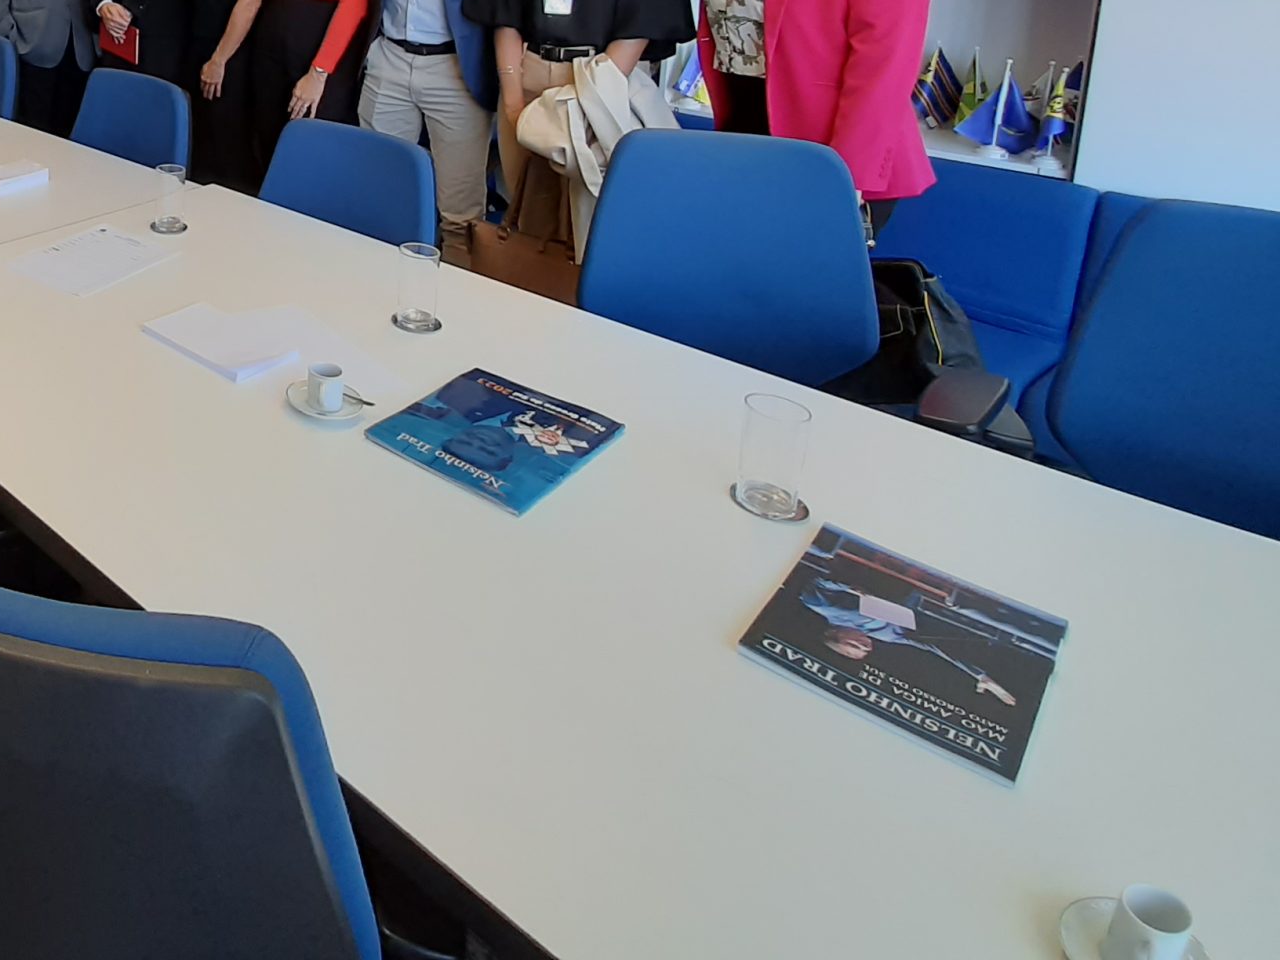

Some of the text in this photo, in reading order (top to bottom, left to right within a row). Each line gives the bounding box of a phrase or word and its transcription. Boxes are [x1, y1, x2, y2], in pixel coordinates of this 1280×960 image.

[396, 432, 506, 489] Nelsinho Trad
[762, 638, 1001, 761] NELSINHO TRAD
[858, 669, 882, 687] DE
[863, 664, 1008, 734] MATO GROSSO DO SUL
[891, 685, 952, 718] AMIGA
